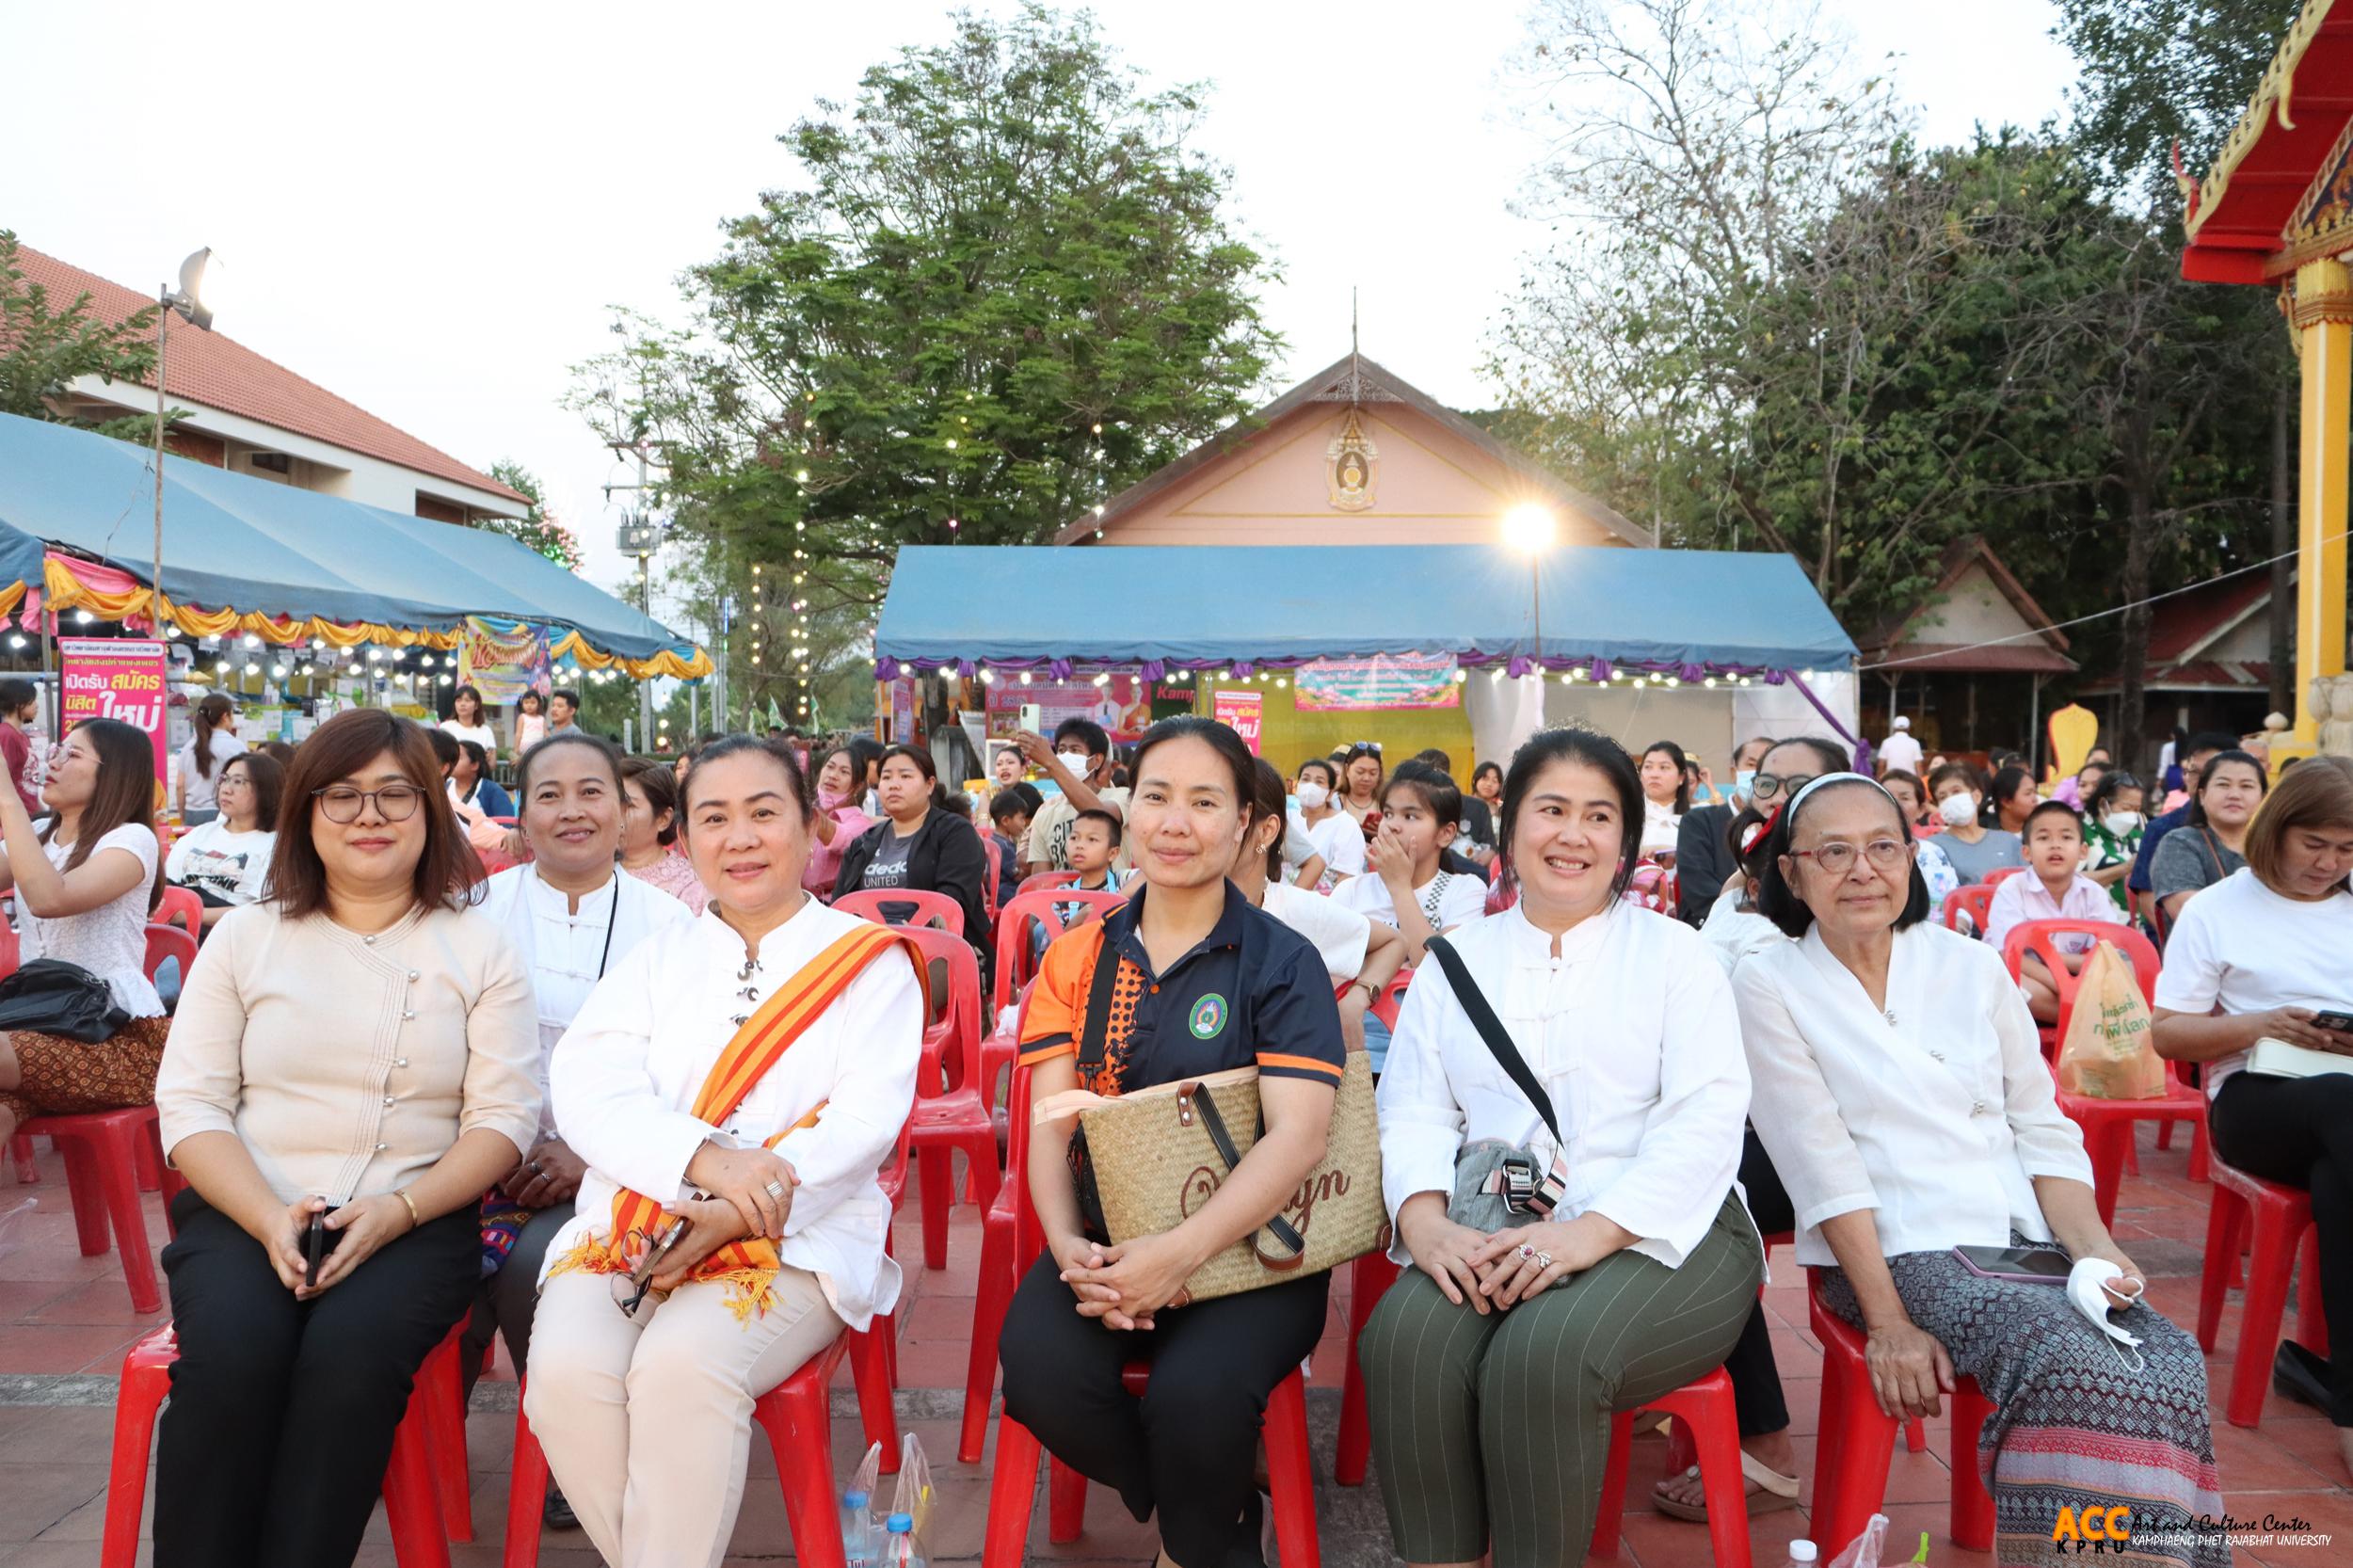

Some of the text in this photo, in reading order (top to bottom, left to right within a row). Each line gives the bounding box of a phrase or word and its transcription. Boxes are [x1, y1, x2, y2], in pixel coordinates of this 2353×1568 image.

[65, 669, 161, 690] เปิดรับ สมัคร
[65, 691, 162, 732] นิสิต ใหม่
[864, 875, 898, 888] UNITED
